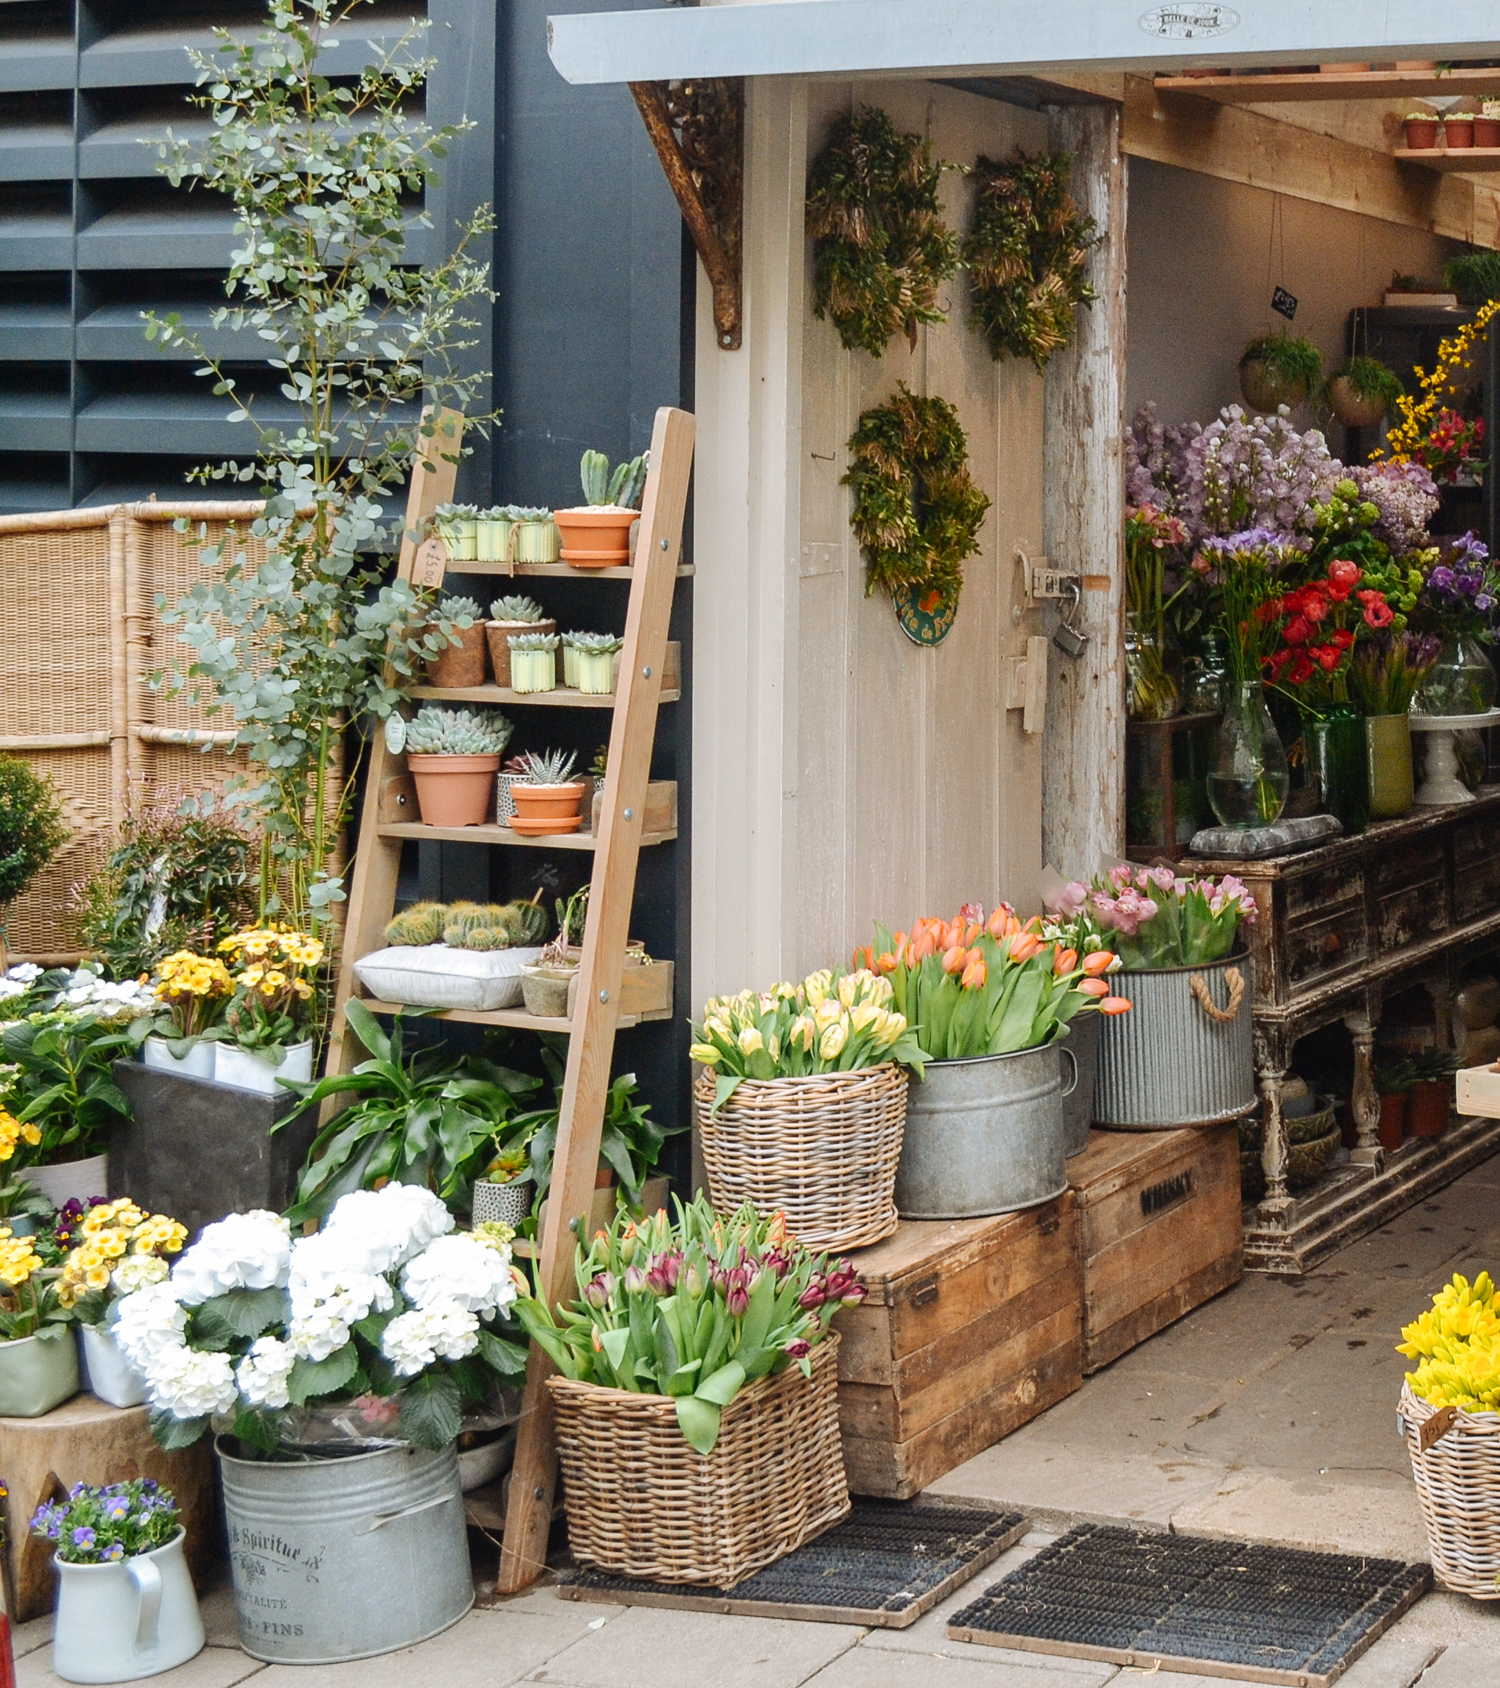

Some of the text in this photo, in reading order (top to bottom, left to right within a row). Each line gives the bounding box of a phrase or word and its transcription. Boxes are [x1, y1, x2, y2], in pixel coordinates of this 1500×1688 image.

[1164, 14, 1185, 23] BELLE
[1196, 18, 1215, 27] JOUR
[425, 552, 441, 583] £5.00
[262, 1621, 305, 1637] FINS
